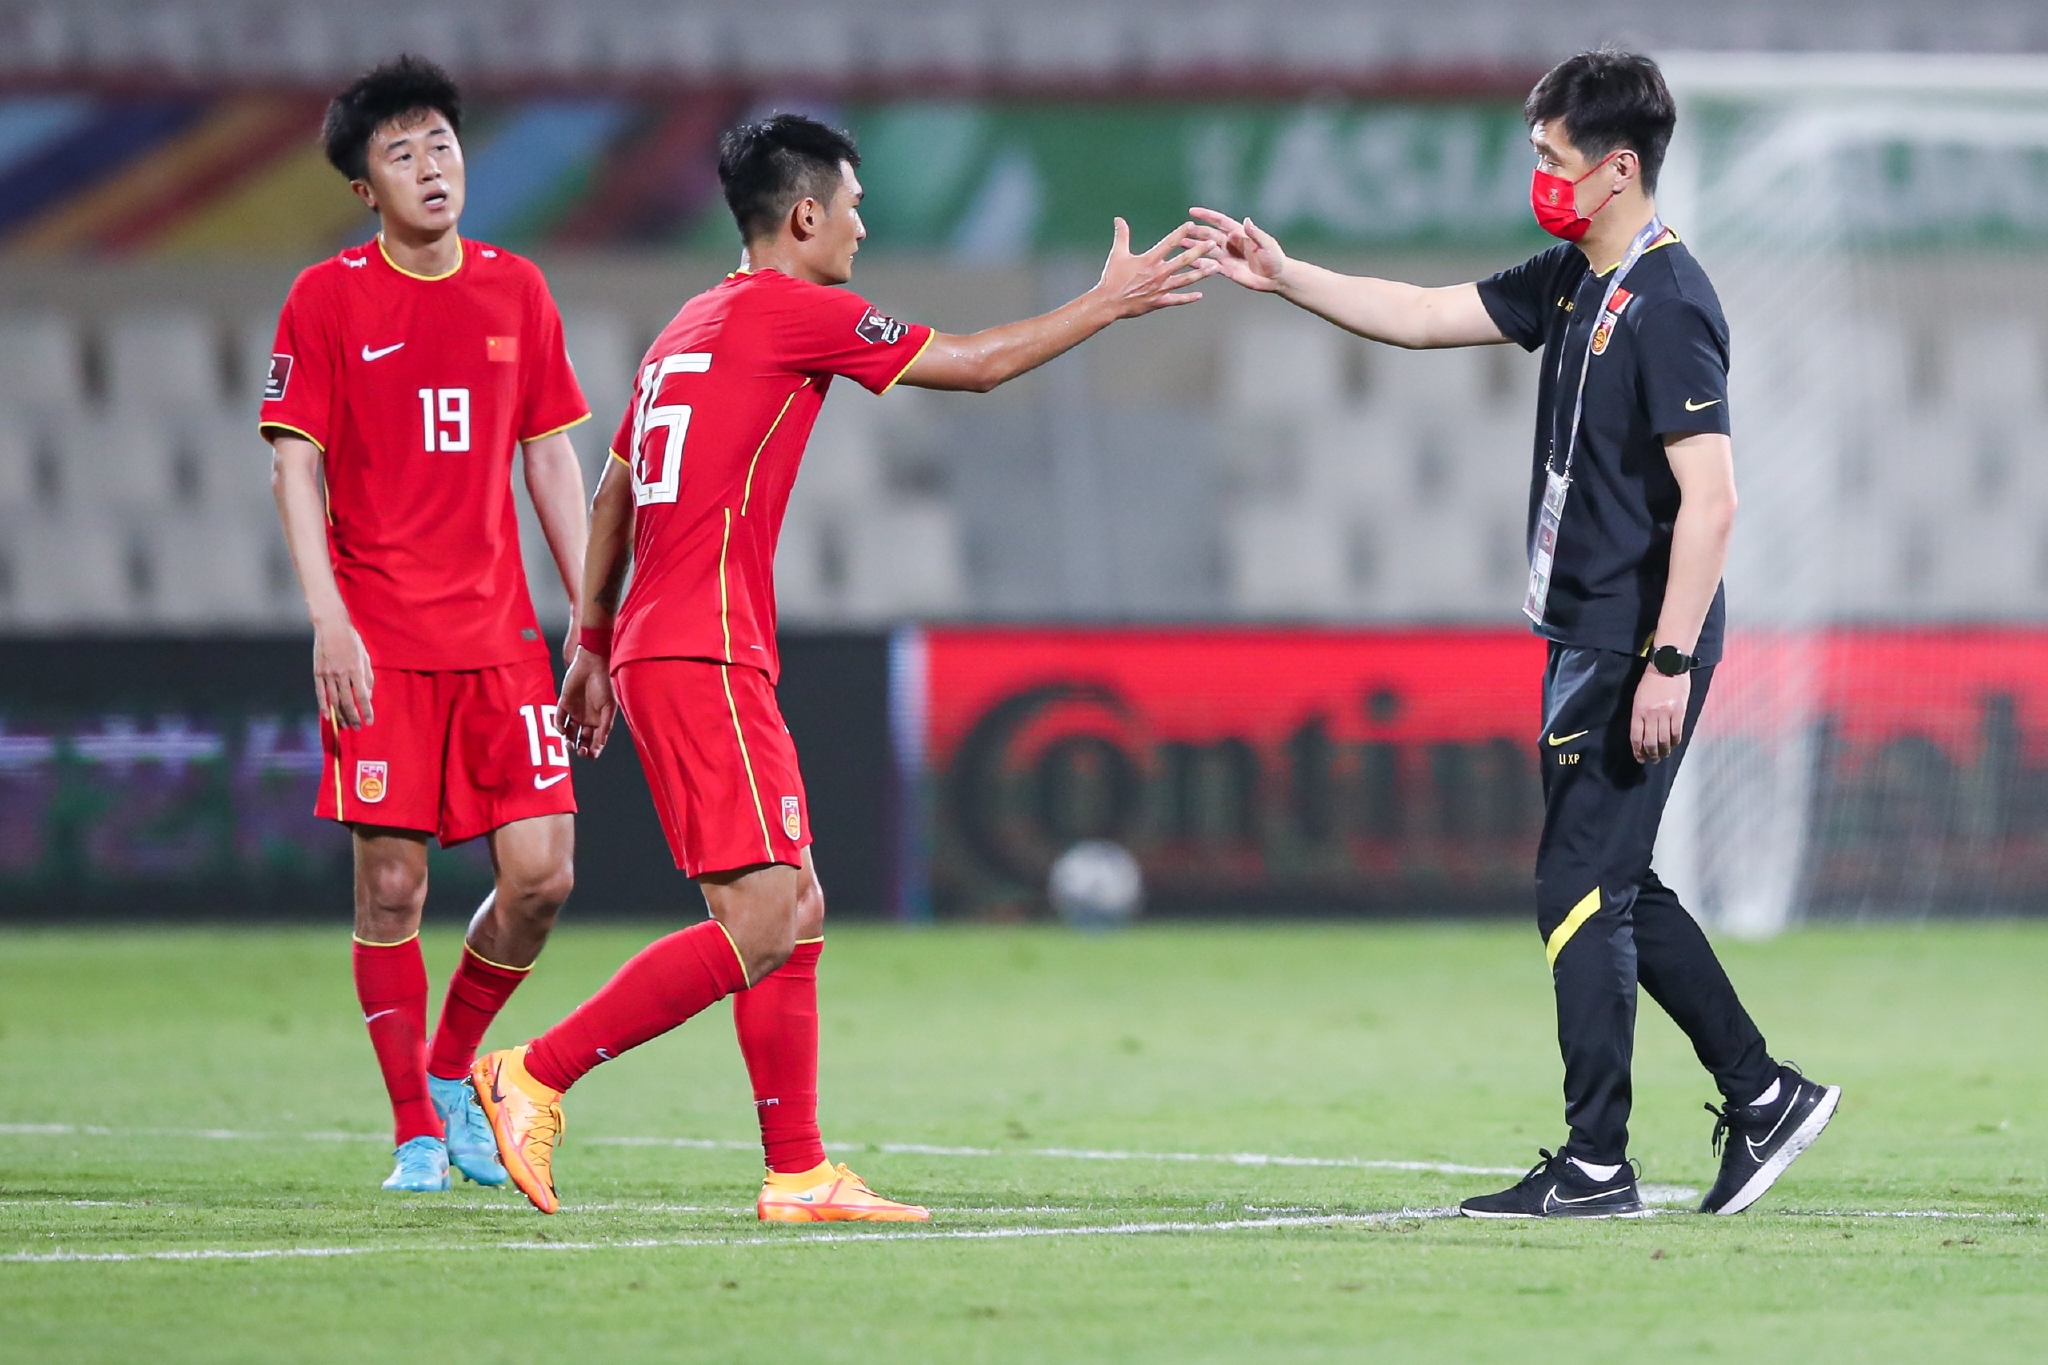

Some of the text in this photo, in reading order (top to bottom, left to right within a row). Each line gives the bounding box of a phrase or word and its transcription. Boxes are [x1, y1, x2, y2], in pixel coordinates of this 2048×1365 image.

[418, 387, 470, 452] 19
[629, 352, 713, 507] 15
[1558, 753, 1581, 765] LI XP
